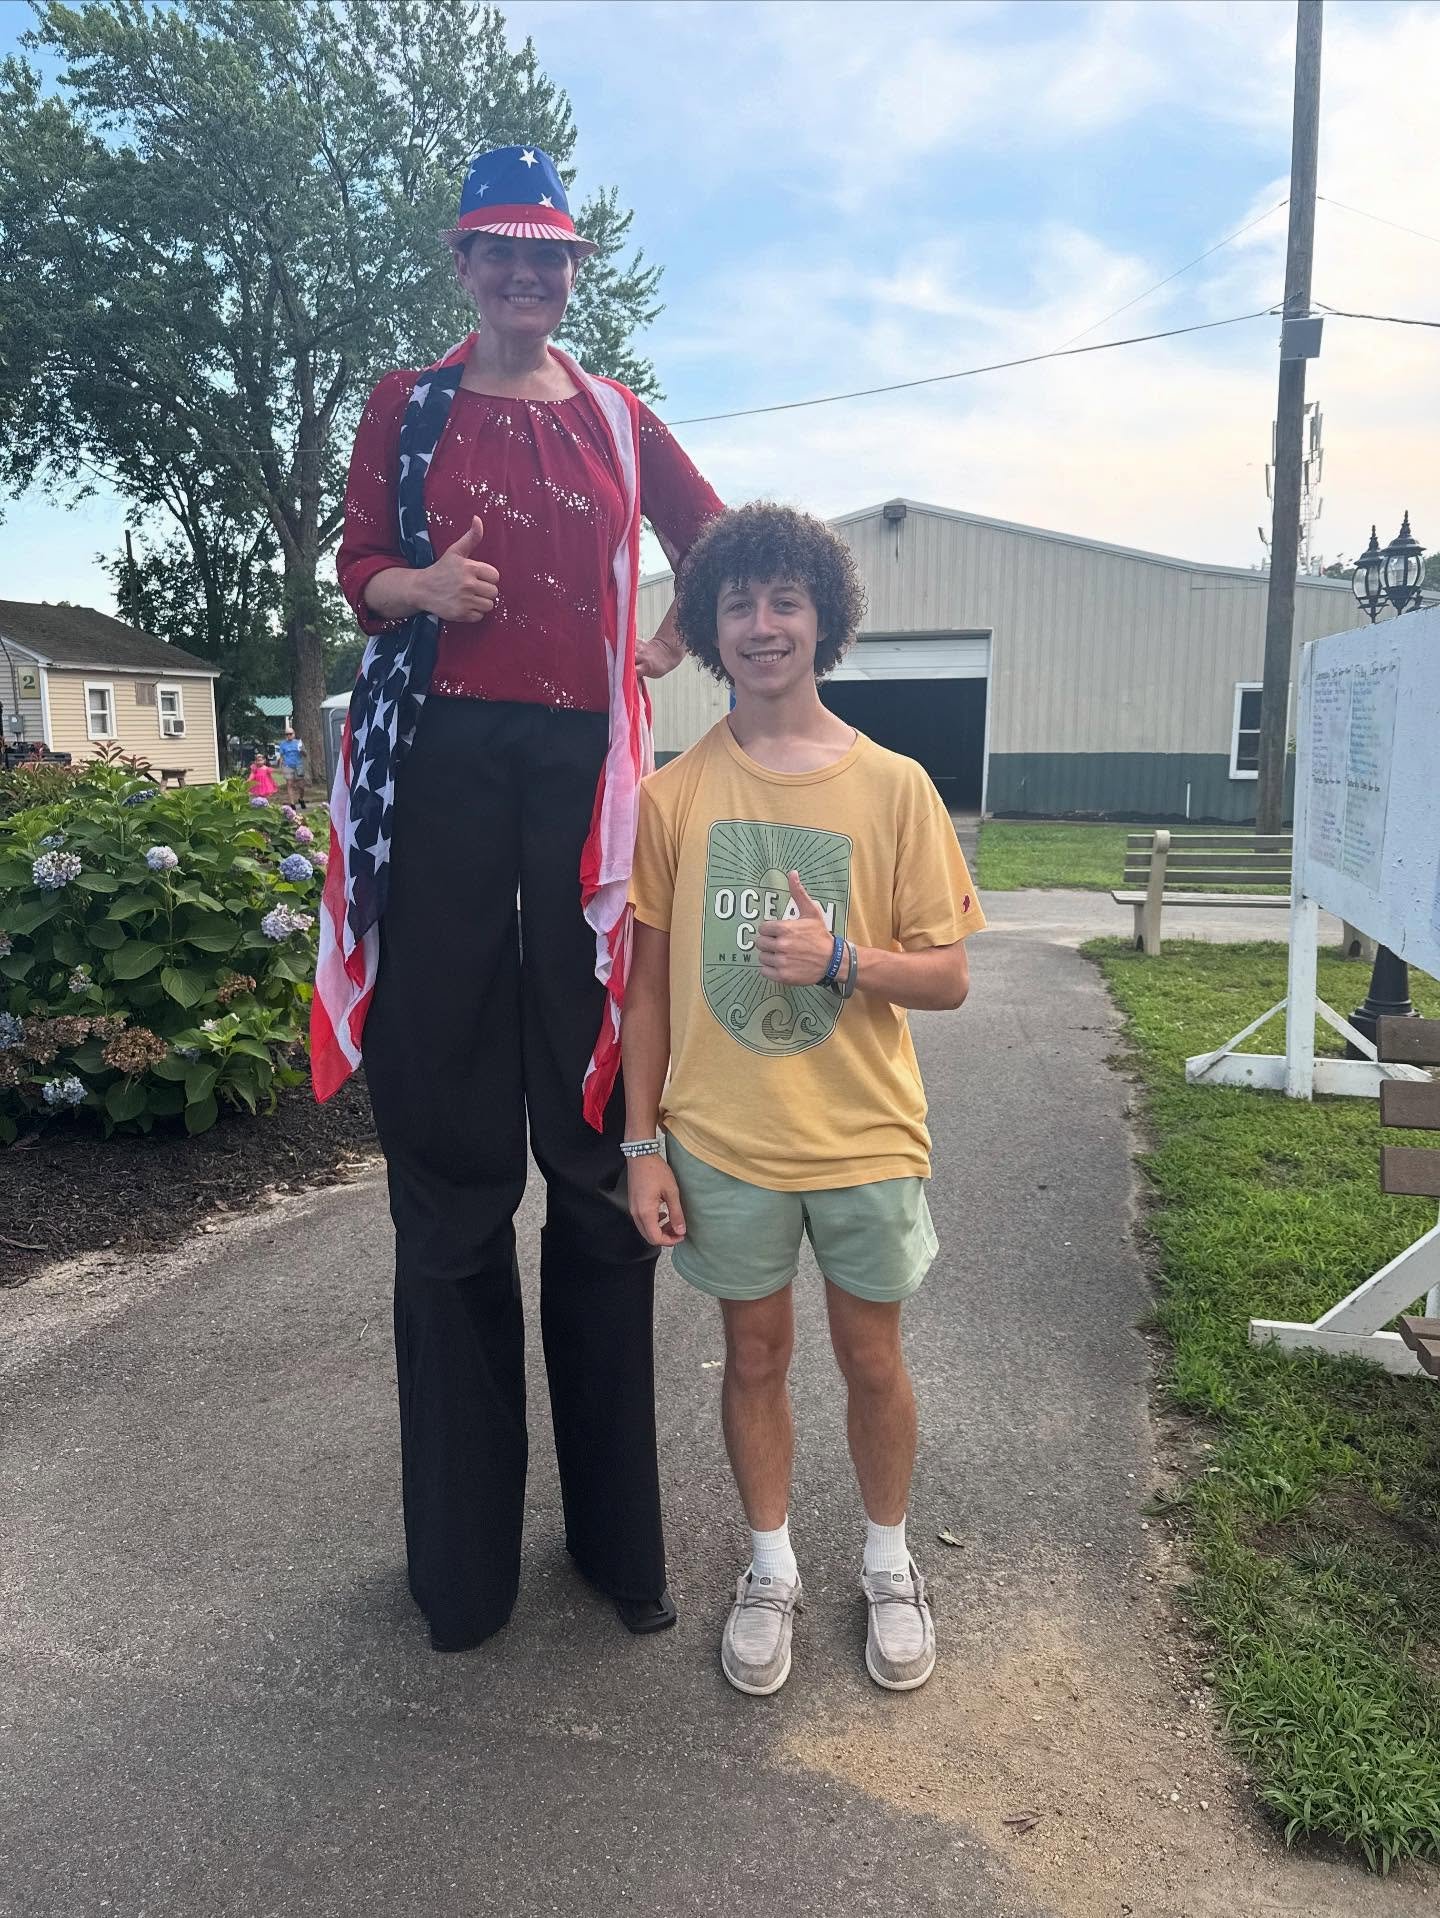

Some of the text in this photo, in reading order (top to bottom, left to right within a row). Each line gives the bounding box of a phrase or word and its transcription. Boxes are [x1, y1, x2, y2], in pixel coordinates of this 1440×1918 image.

[22, 674, 36, 690] 2
[714, 887, 836, 933] OCEAN
[718, 952, 752, 963] NEW
